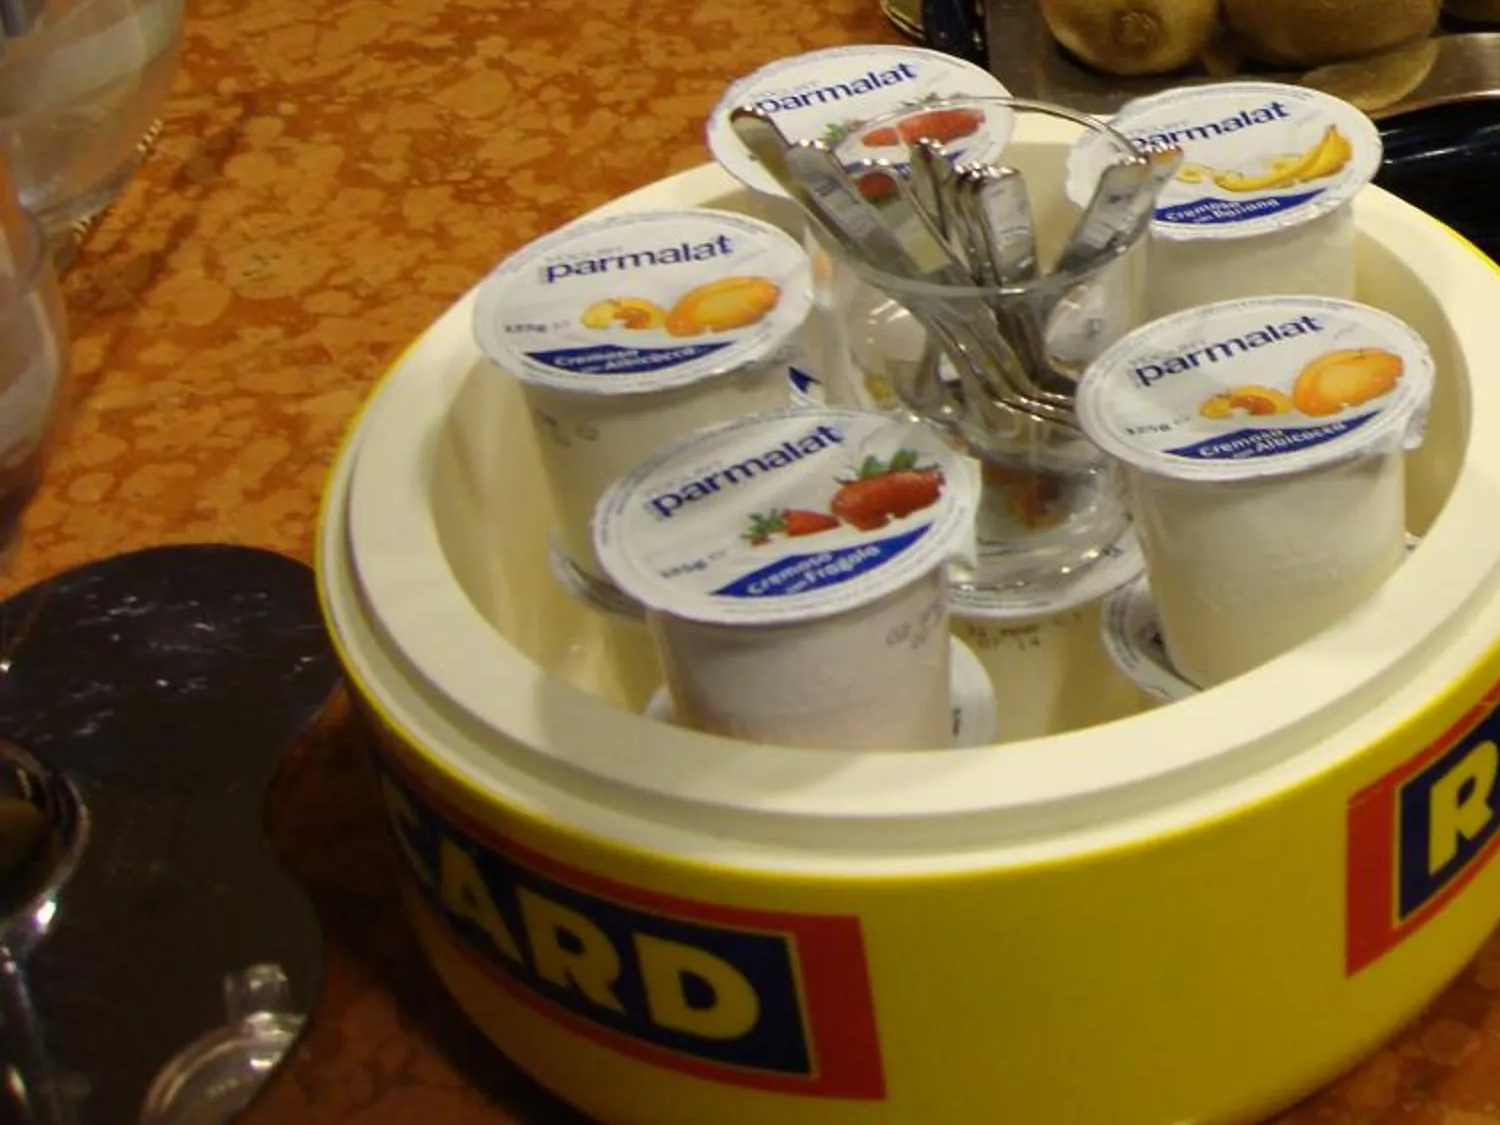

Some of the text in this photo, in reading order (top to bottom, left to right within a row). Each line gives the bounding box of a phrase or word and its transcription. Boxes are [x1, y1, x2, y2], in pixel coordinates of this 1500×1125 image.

[755, 61, 919, 113] parmalat
[544, 234, 734, 283] parmalat
[1134, 315, 1325, 389] parmalat
[650, 424, 846, 520] parmalat
